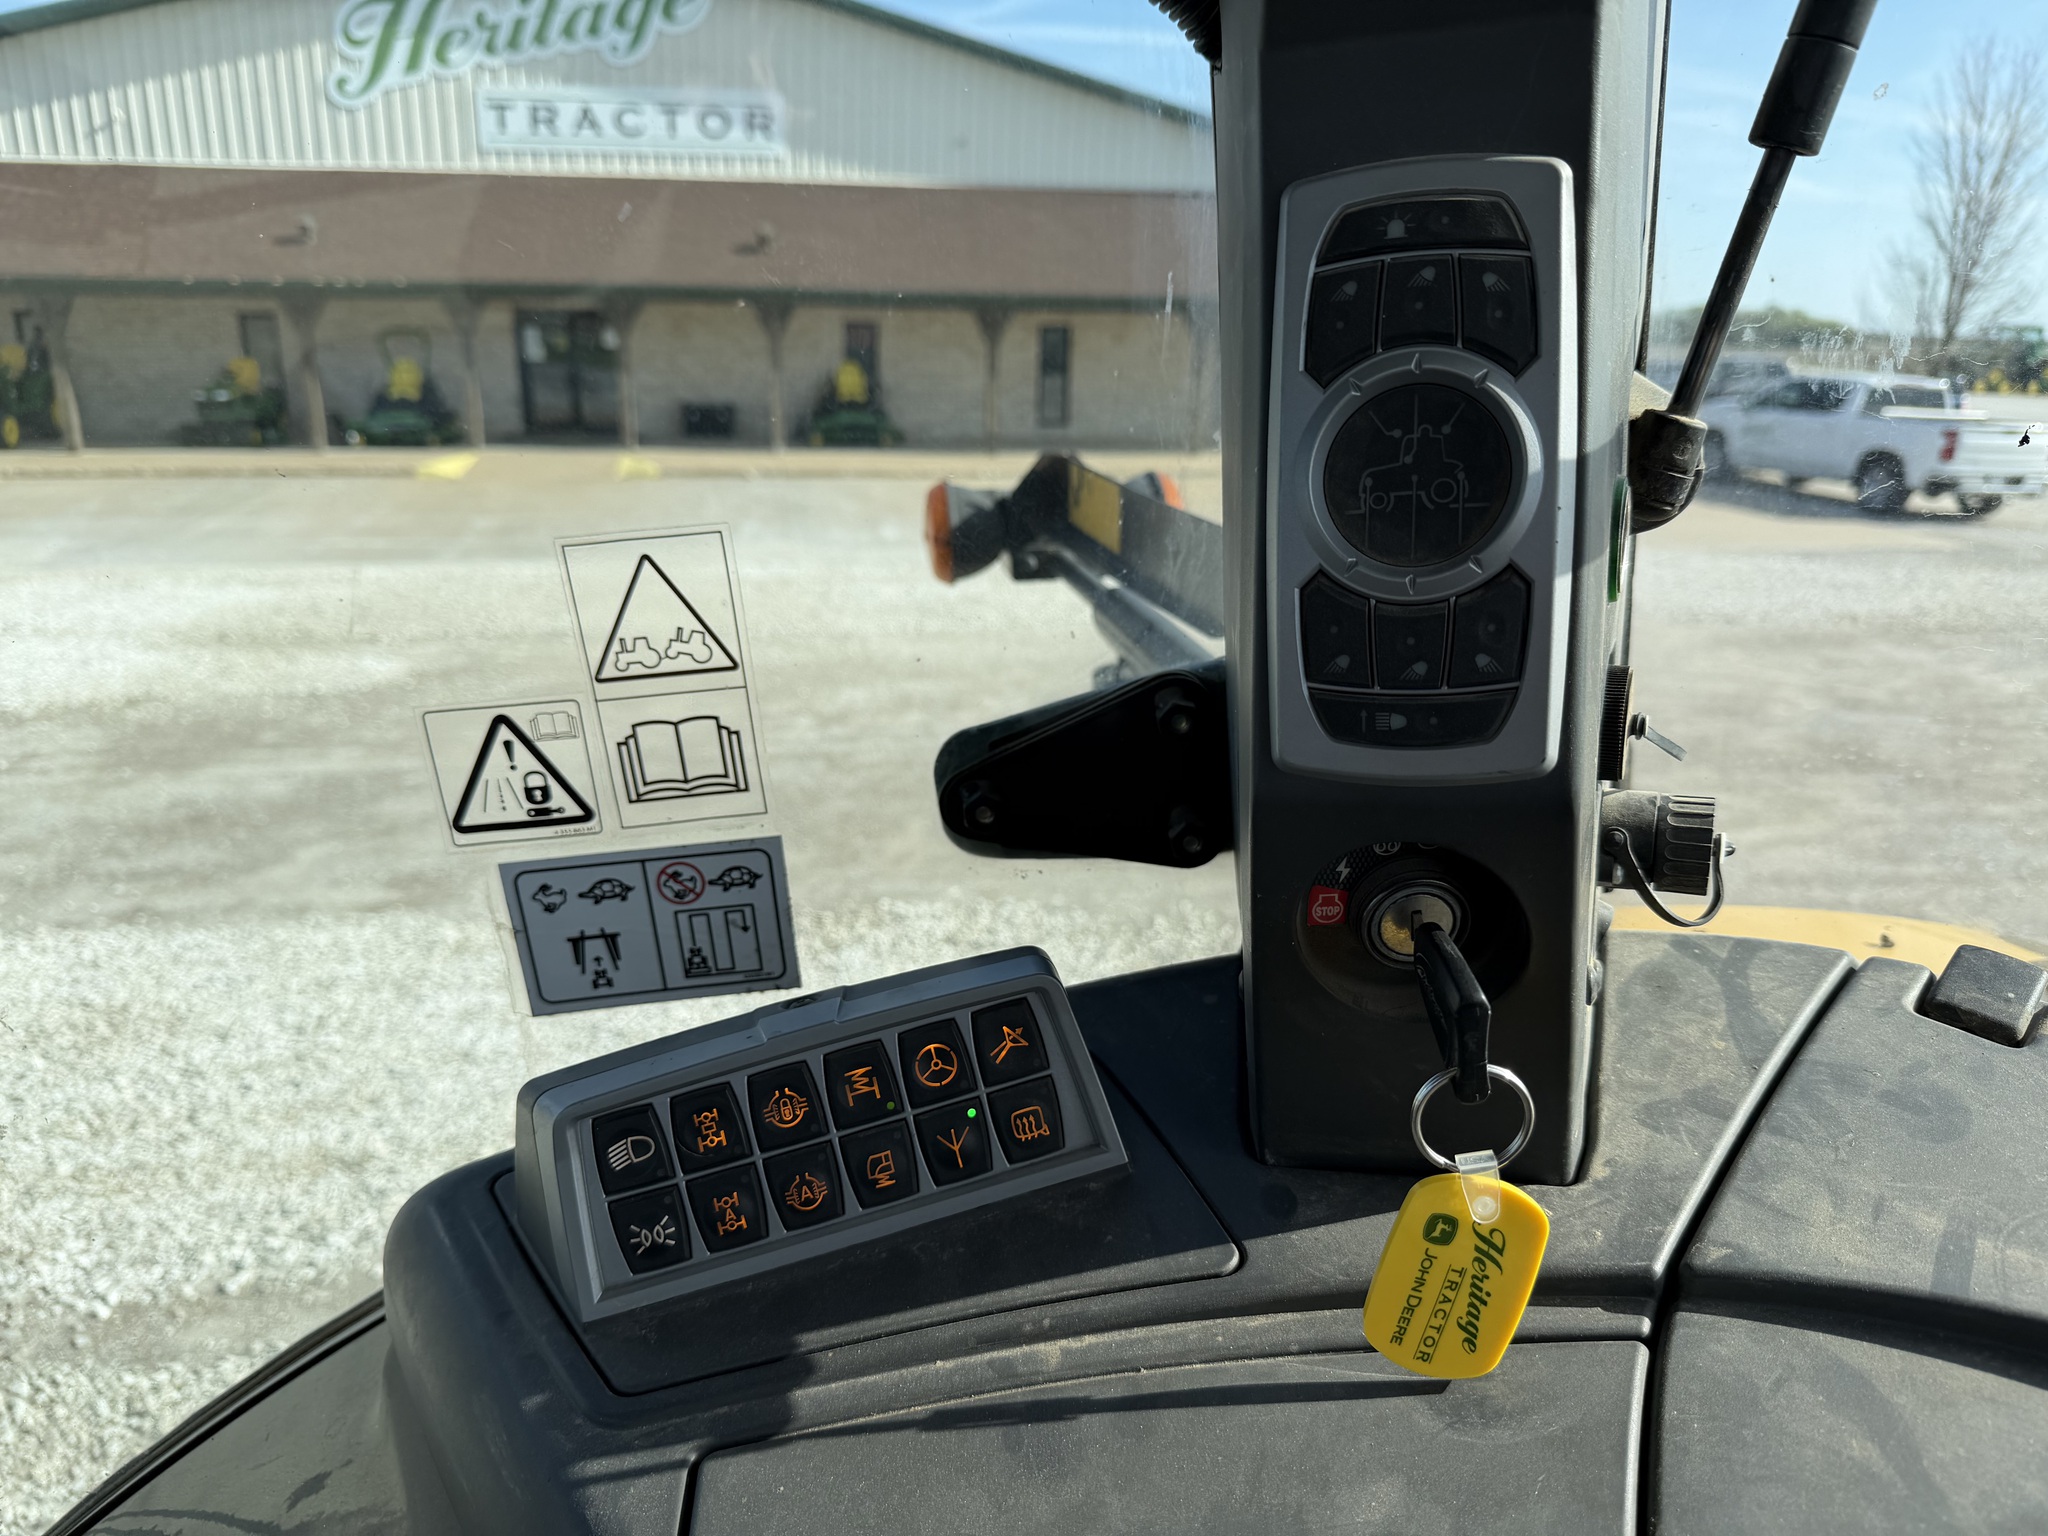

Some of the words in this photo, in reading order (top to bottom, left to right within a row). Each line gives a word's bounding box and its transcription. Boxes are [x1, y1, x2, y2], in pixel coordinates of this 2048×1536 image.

[487, 103, 776, 142] TRACTOR
[1315, 905, 1340, 917] STOP
[801, 1185, 814, 1202] A
[725, 1208, 737, 1222] A
[1413, 1248, 1438, 1294] JOHN
[1456, 1220, 1506, 1355] Heritage
[1390, 1296, 1422, 1346] DEERE
[1416, 1267, 1465, 1363] TRACTOR
